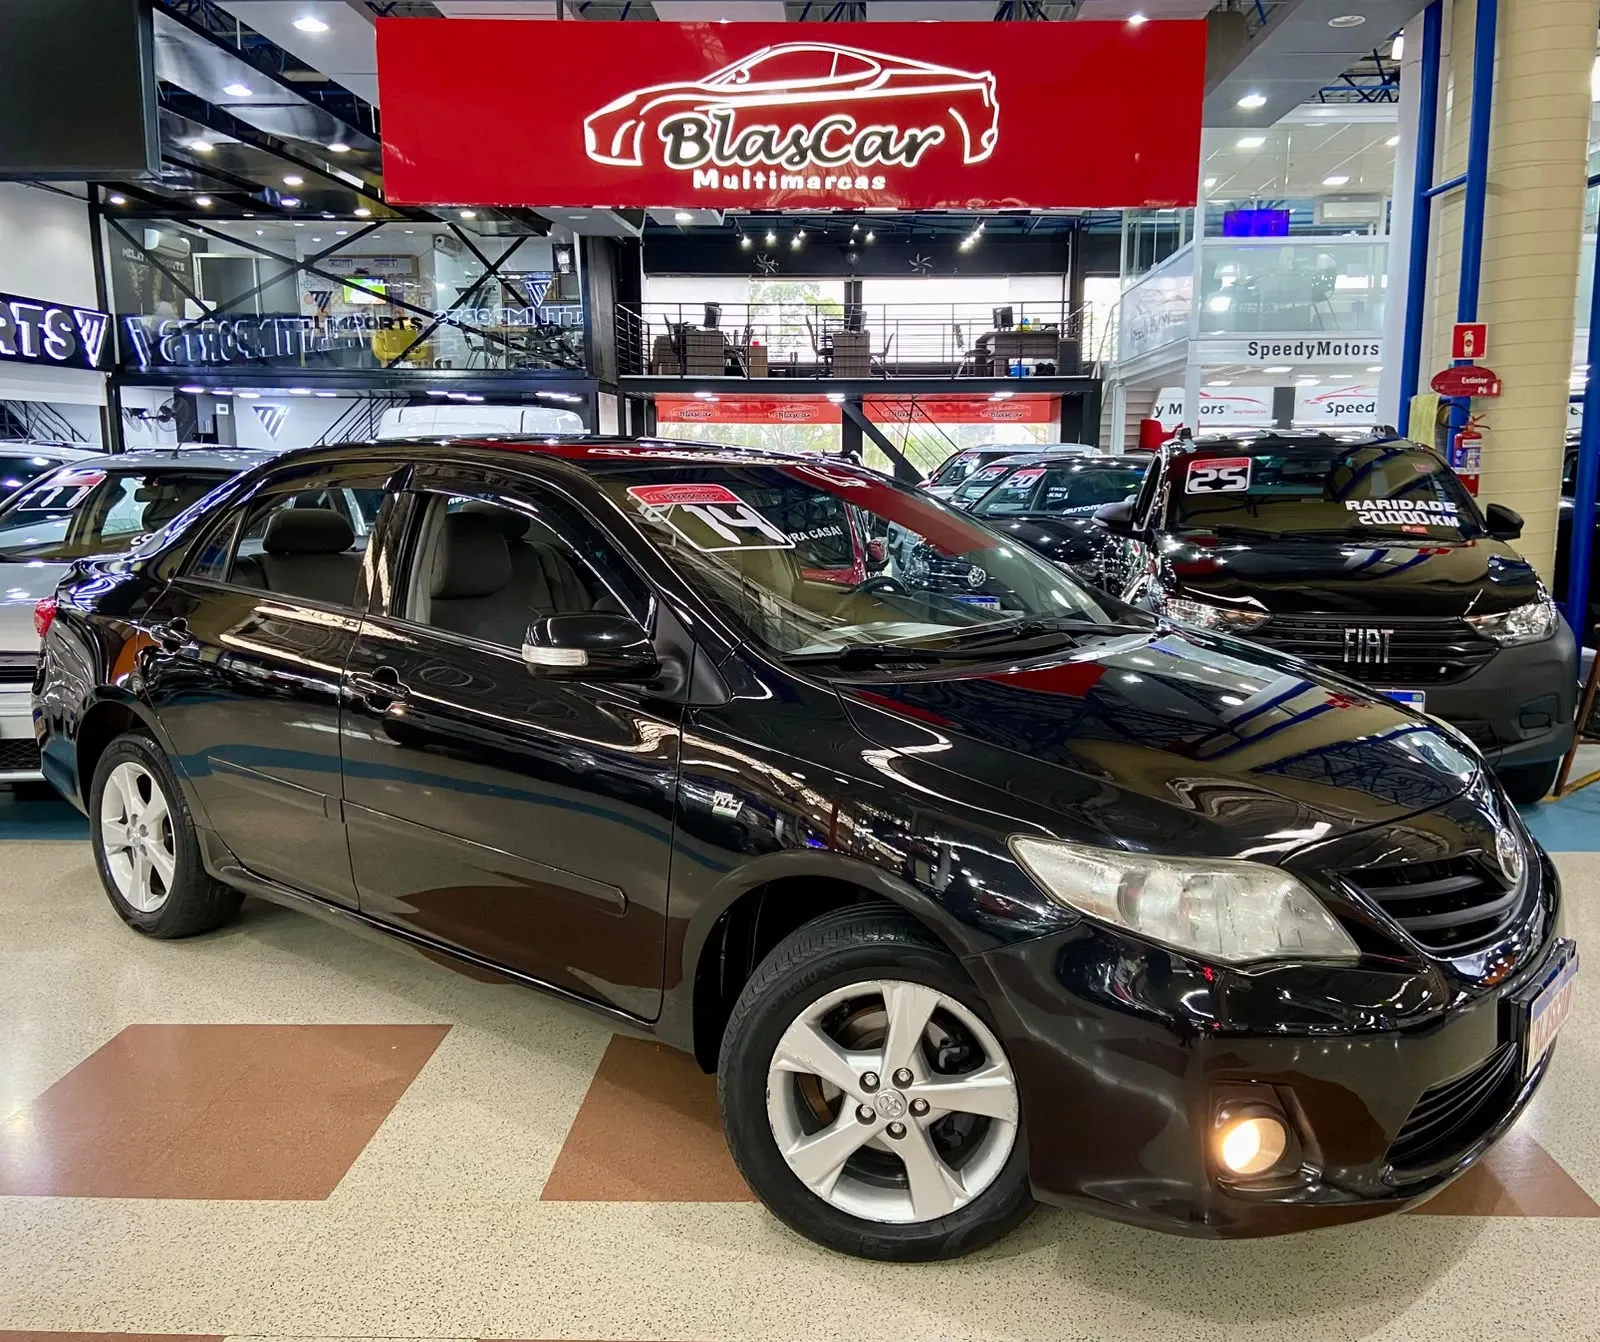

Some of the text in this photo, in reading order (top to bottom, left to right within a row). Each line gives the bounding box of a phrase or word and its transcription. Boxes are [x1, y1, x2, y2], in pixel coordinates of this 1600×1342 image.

[659, 110, 944, 170] BlasCar
[693, 169, 886, 191] Multimarcas
[1247, 341, 1380, 360] SpeedyMotors
[1168, 403, 1225, 415] Mors
[1326, 401, 1377, 417] Speed
[1188, 468, 1247, 492] 25
[1344, 500, 1459, 513] RARIDADE
[680, 504, 786, 546] 14
[808, 525, 843, 539] CASA!
[1343, 628, 1394, 664] FIAT
